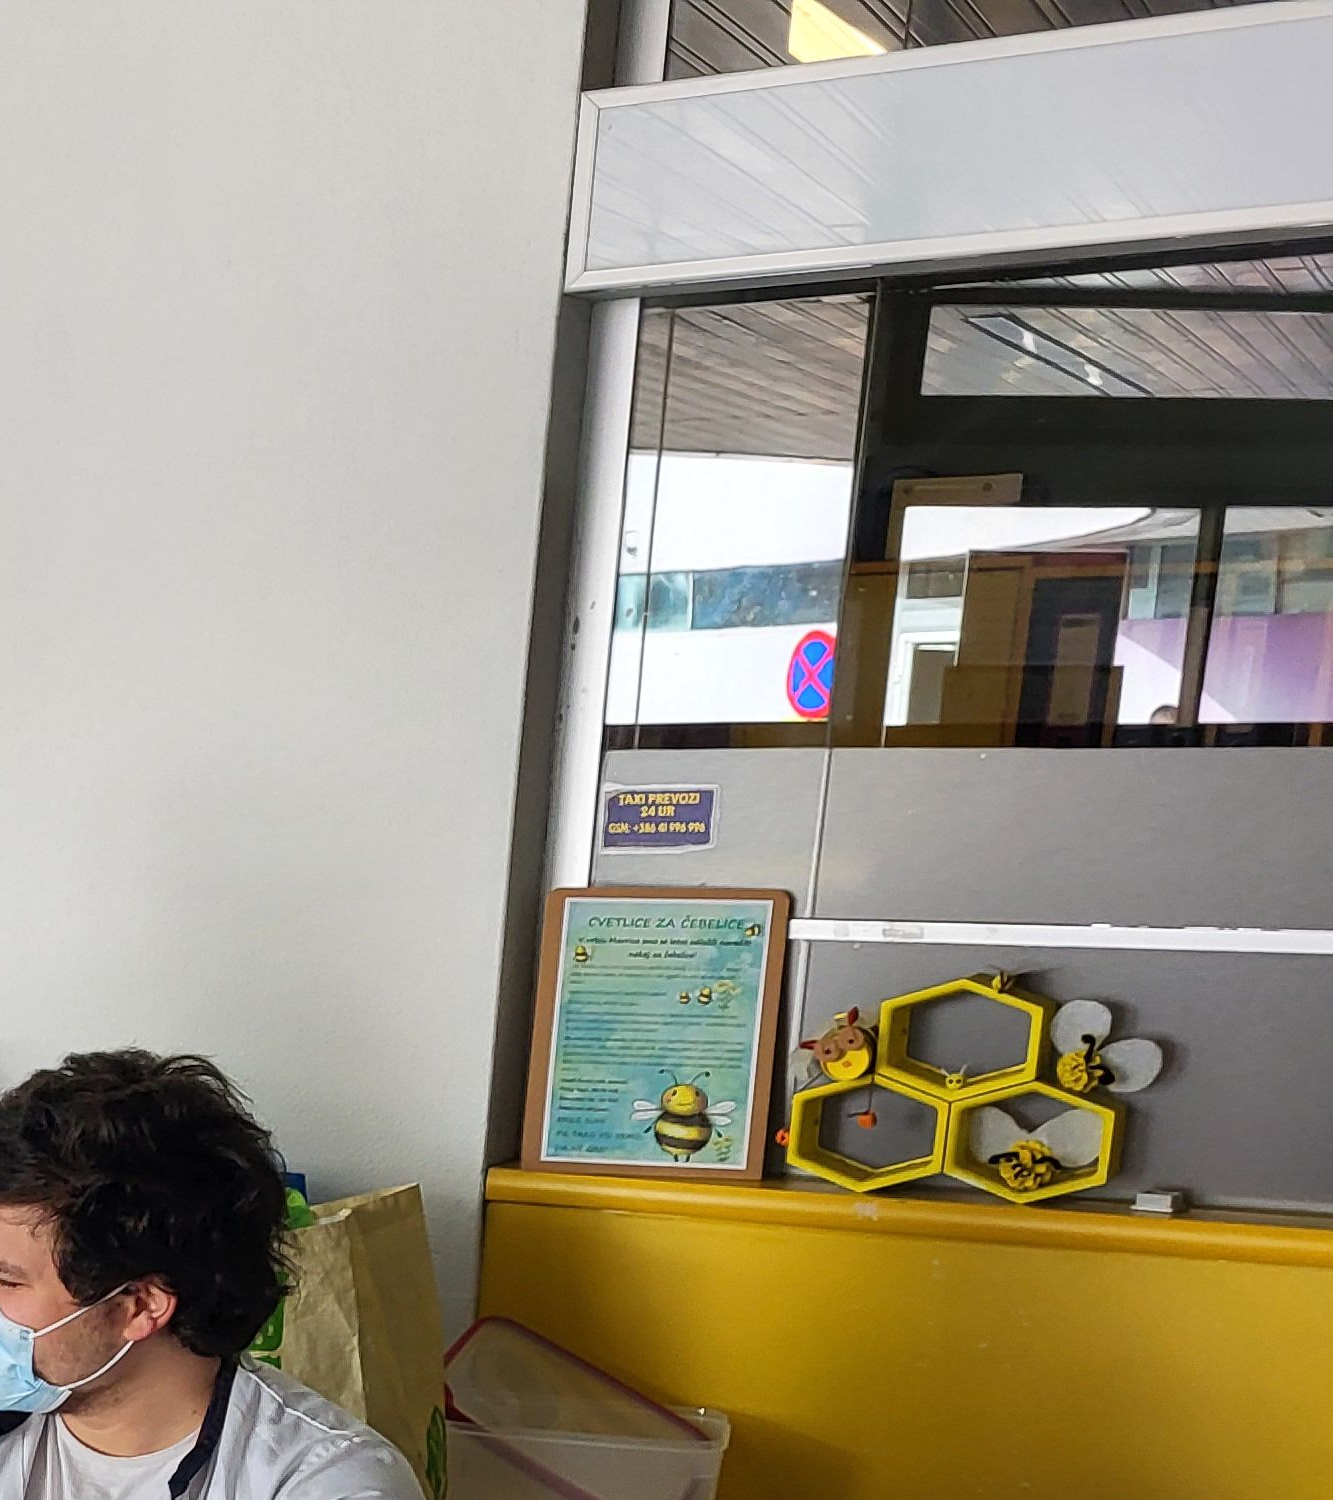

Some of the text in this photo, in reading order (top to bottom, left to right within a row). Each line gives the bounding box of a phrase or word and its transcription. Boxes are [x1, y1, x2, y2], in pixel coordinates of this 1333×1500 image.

[618, 793, 700, 805] TAXI PREVOZI
[641, 806, 675, 817] 24 UR
[589, 915, 744, 930] CVETLICE ZA ČEBELICE
